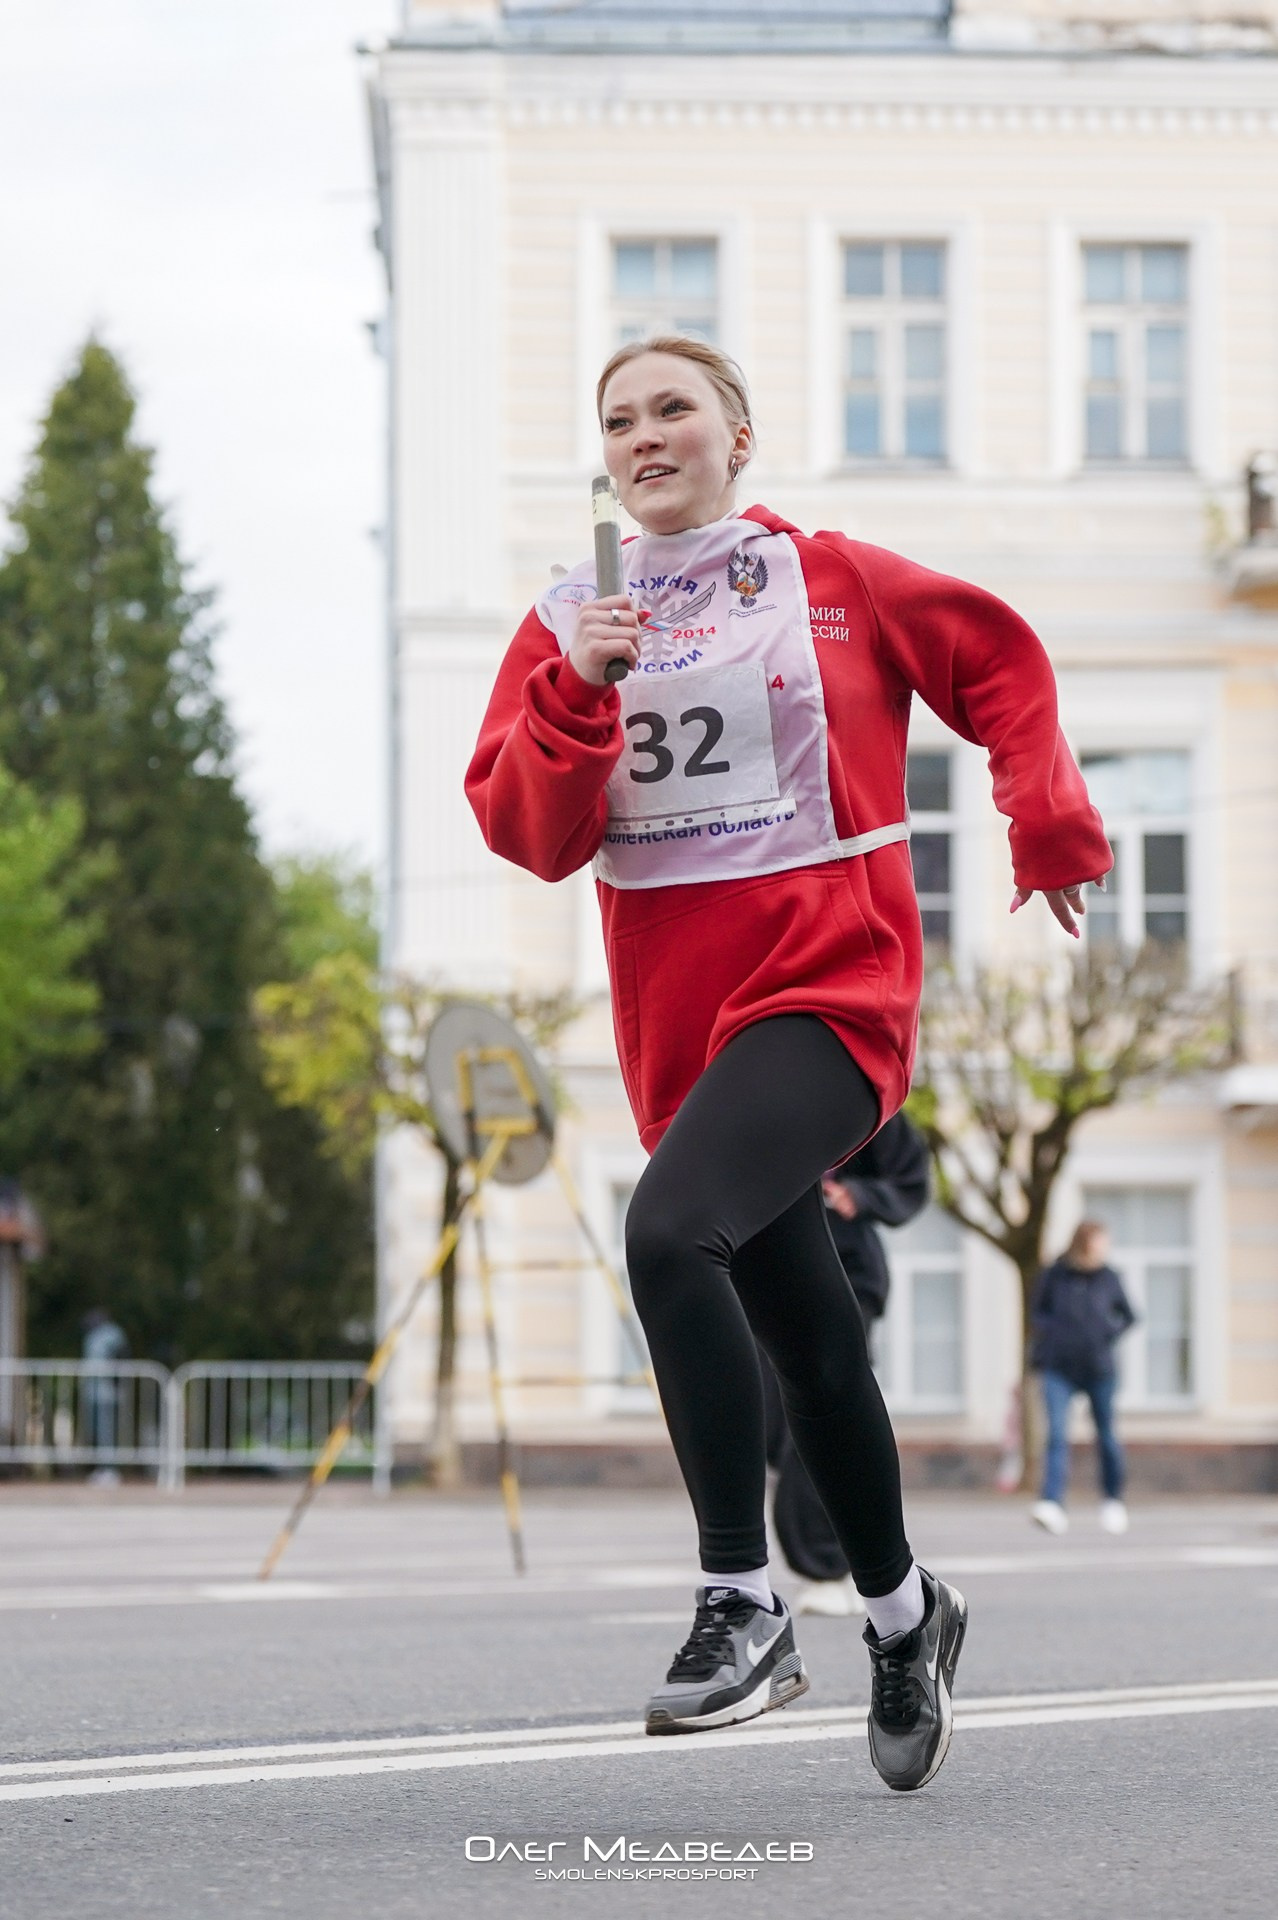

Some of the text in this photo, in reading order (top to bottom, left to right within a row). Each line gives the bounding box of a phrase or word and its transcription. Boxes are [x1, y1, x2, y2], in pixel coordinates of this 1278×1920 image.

[628, 575, 699, 598] ЖНЯ
[809, 606, 846, 622] МИЯ
[671, 626, 717, 640] 2014
[810, 624, 850, 642] ССИИ
[633, 649, 703, 673] ССИИ
[625, 706, 730, 784] 32
